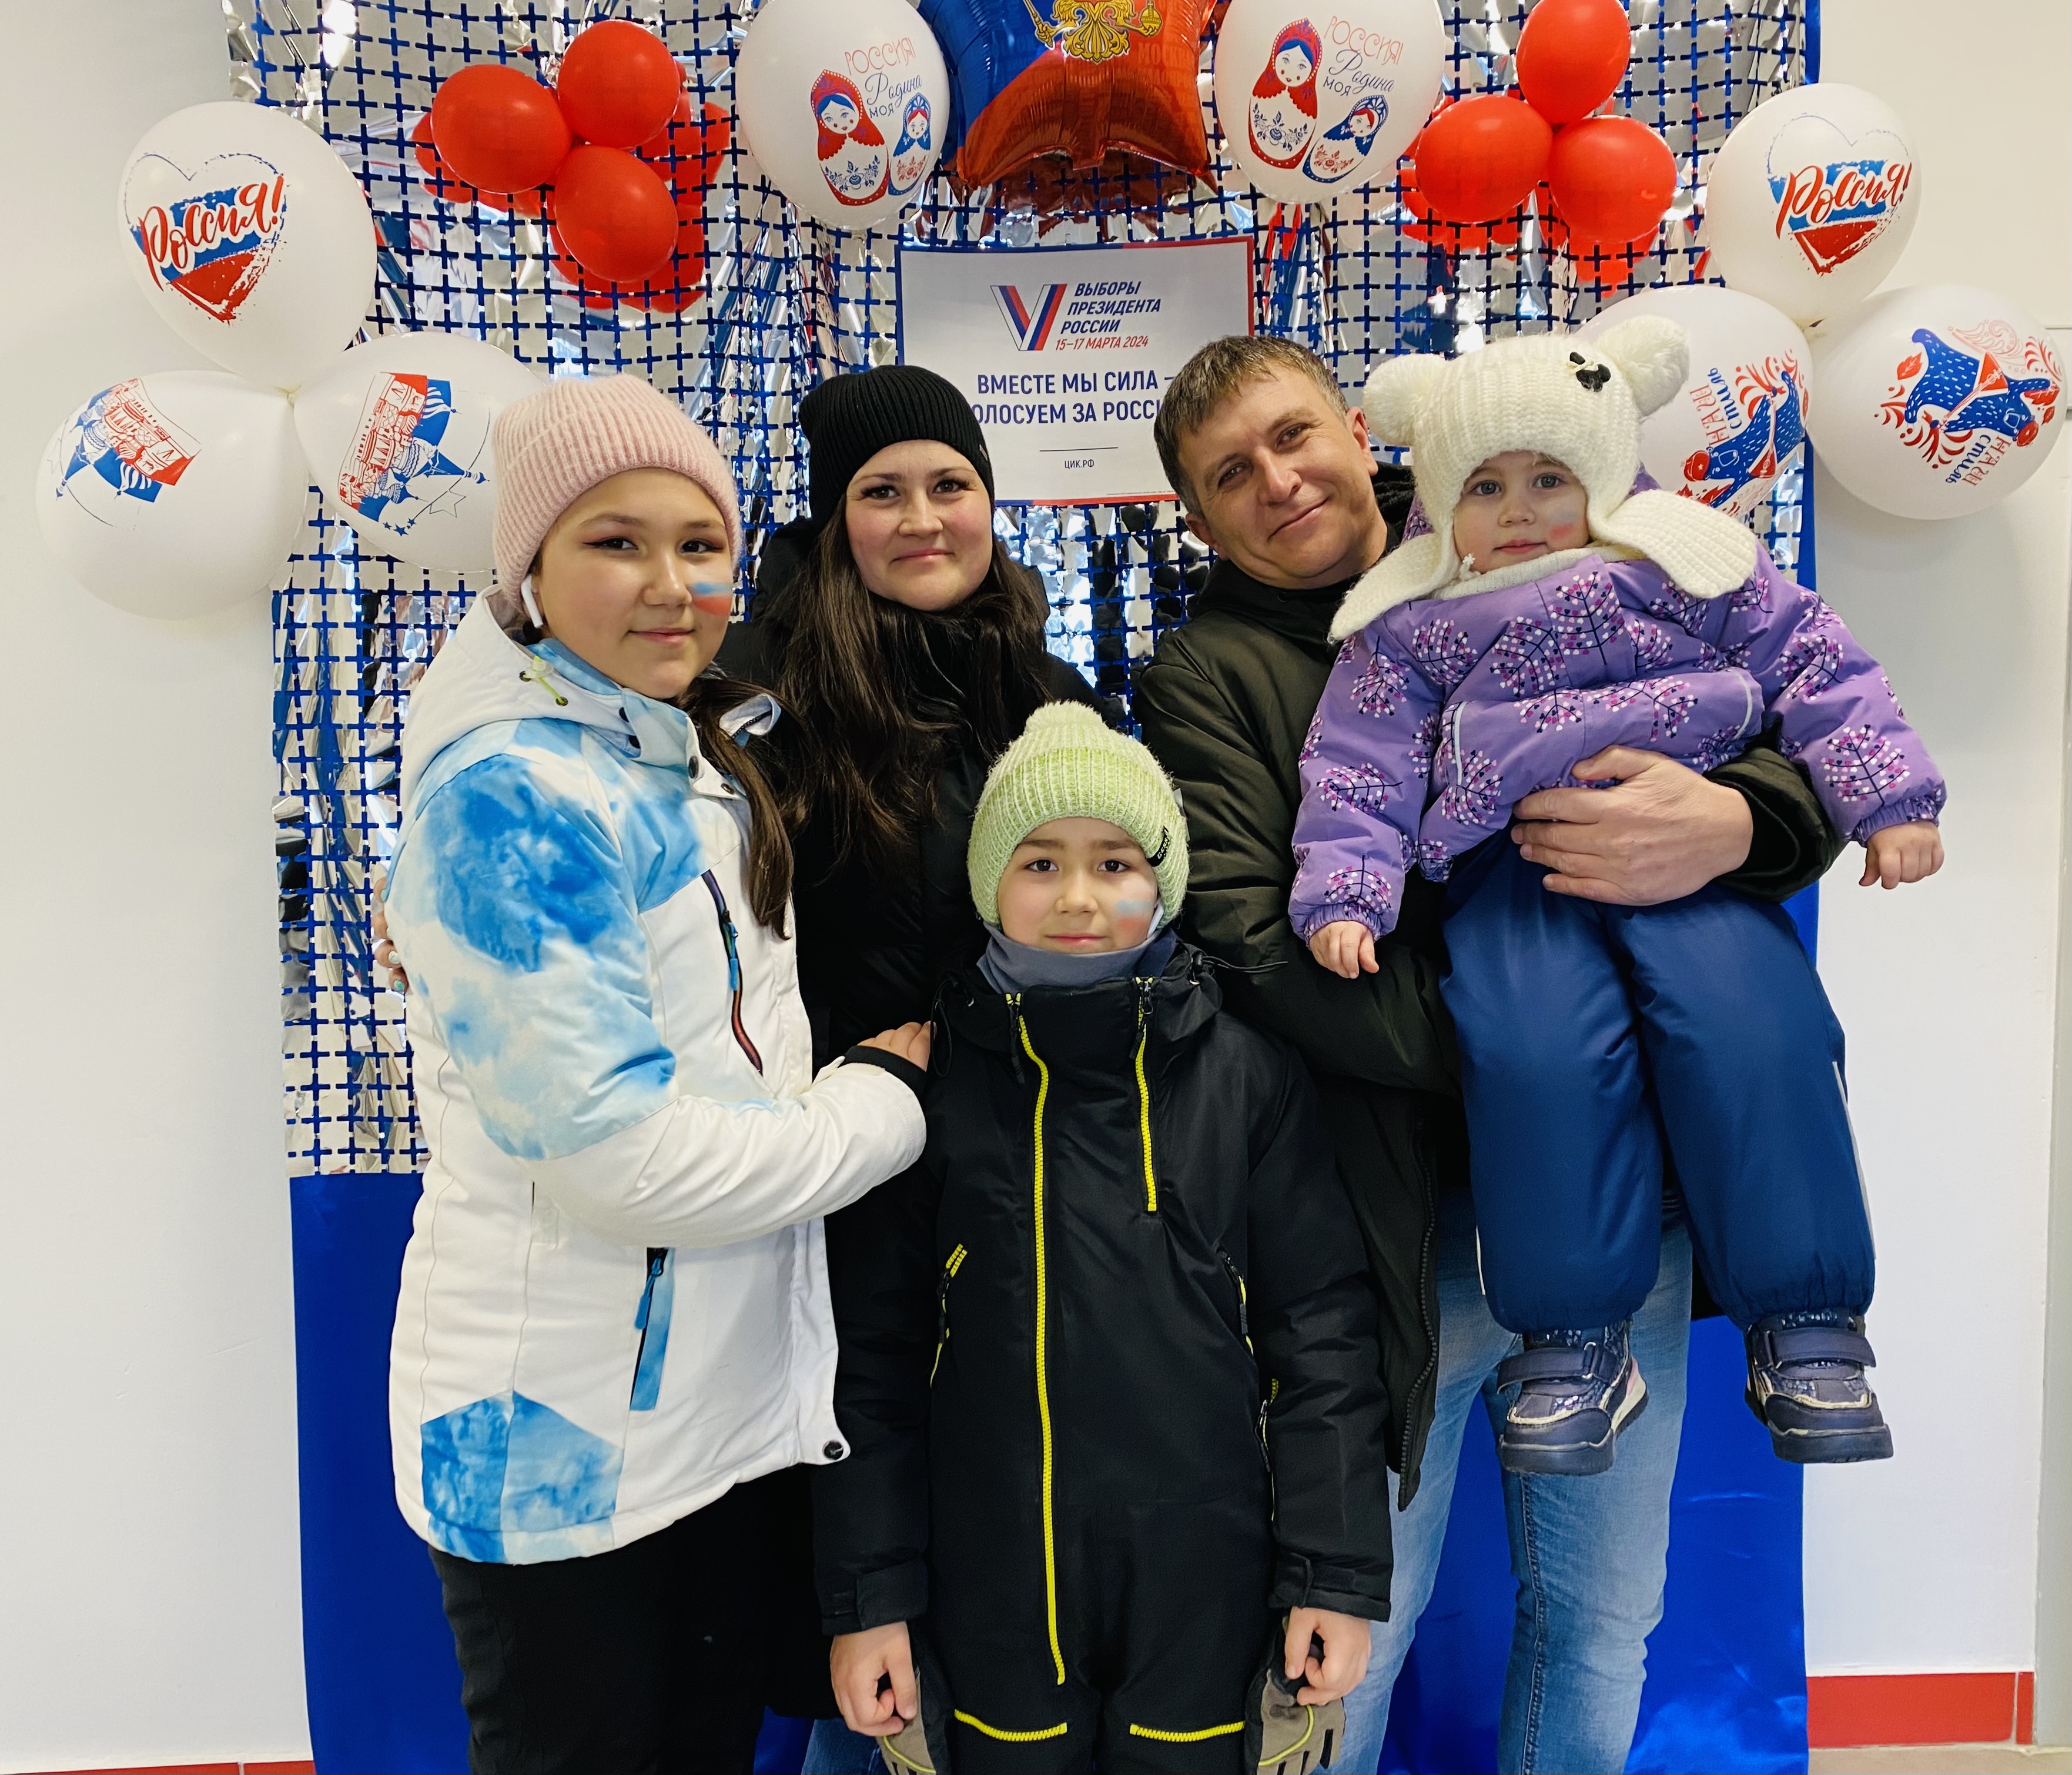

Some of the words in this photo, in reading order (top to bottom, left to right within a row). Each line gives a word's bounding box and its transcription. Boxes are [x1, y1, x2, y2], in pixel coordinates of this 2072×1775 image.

[844, 37, 916, 76] РОССИЯ!
[1324, 15, 1404, 65] РОССИЯ!
[865, 71, 922, 108] Родина
[1328, 49, 1395, 95] Родина
[1776, 161, 1913, 240] Россия!
[138, 175, 284, 292] Россия!
[1067, 299, 1161, 316] ПРЕЗИДЕНТА
[1074, 281, 1142, 296] ВЫБОРЫ
[1060, 319, 1121, 334] РОССИИ
[1085, 336, 1122, 350] МАРТА
[1123, 336, 1149, 348] 2024
[978, 374, 1056, 395] ВМЕСТЕ
[1063, 373, 1097, 393] МЫ
[1104, 370, 1159, 392] СИЛА
[1707, 367, 1742, 429] стиль
[972, 404, 1066, 424] ОЛОСУЕМ
[1073, 402, 1097, 422] ЗА
[1103, 399, 1161, 421] РОСС
[1689, 383, 1730, 447] НАШ
[1065, 459, 1094, 469] ЦИК.РФ
[1946, 434, 1991, 483] стиль
[1961, 435, 2012, 486] НАШ
